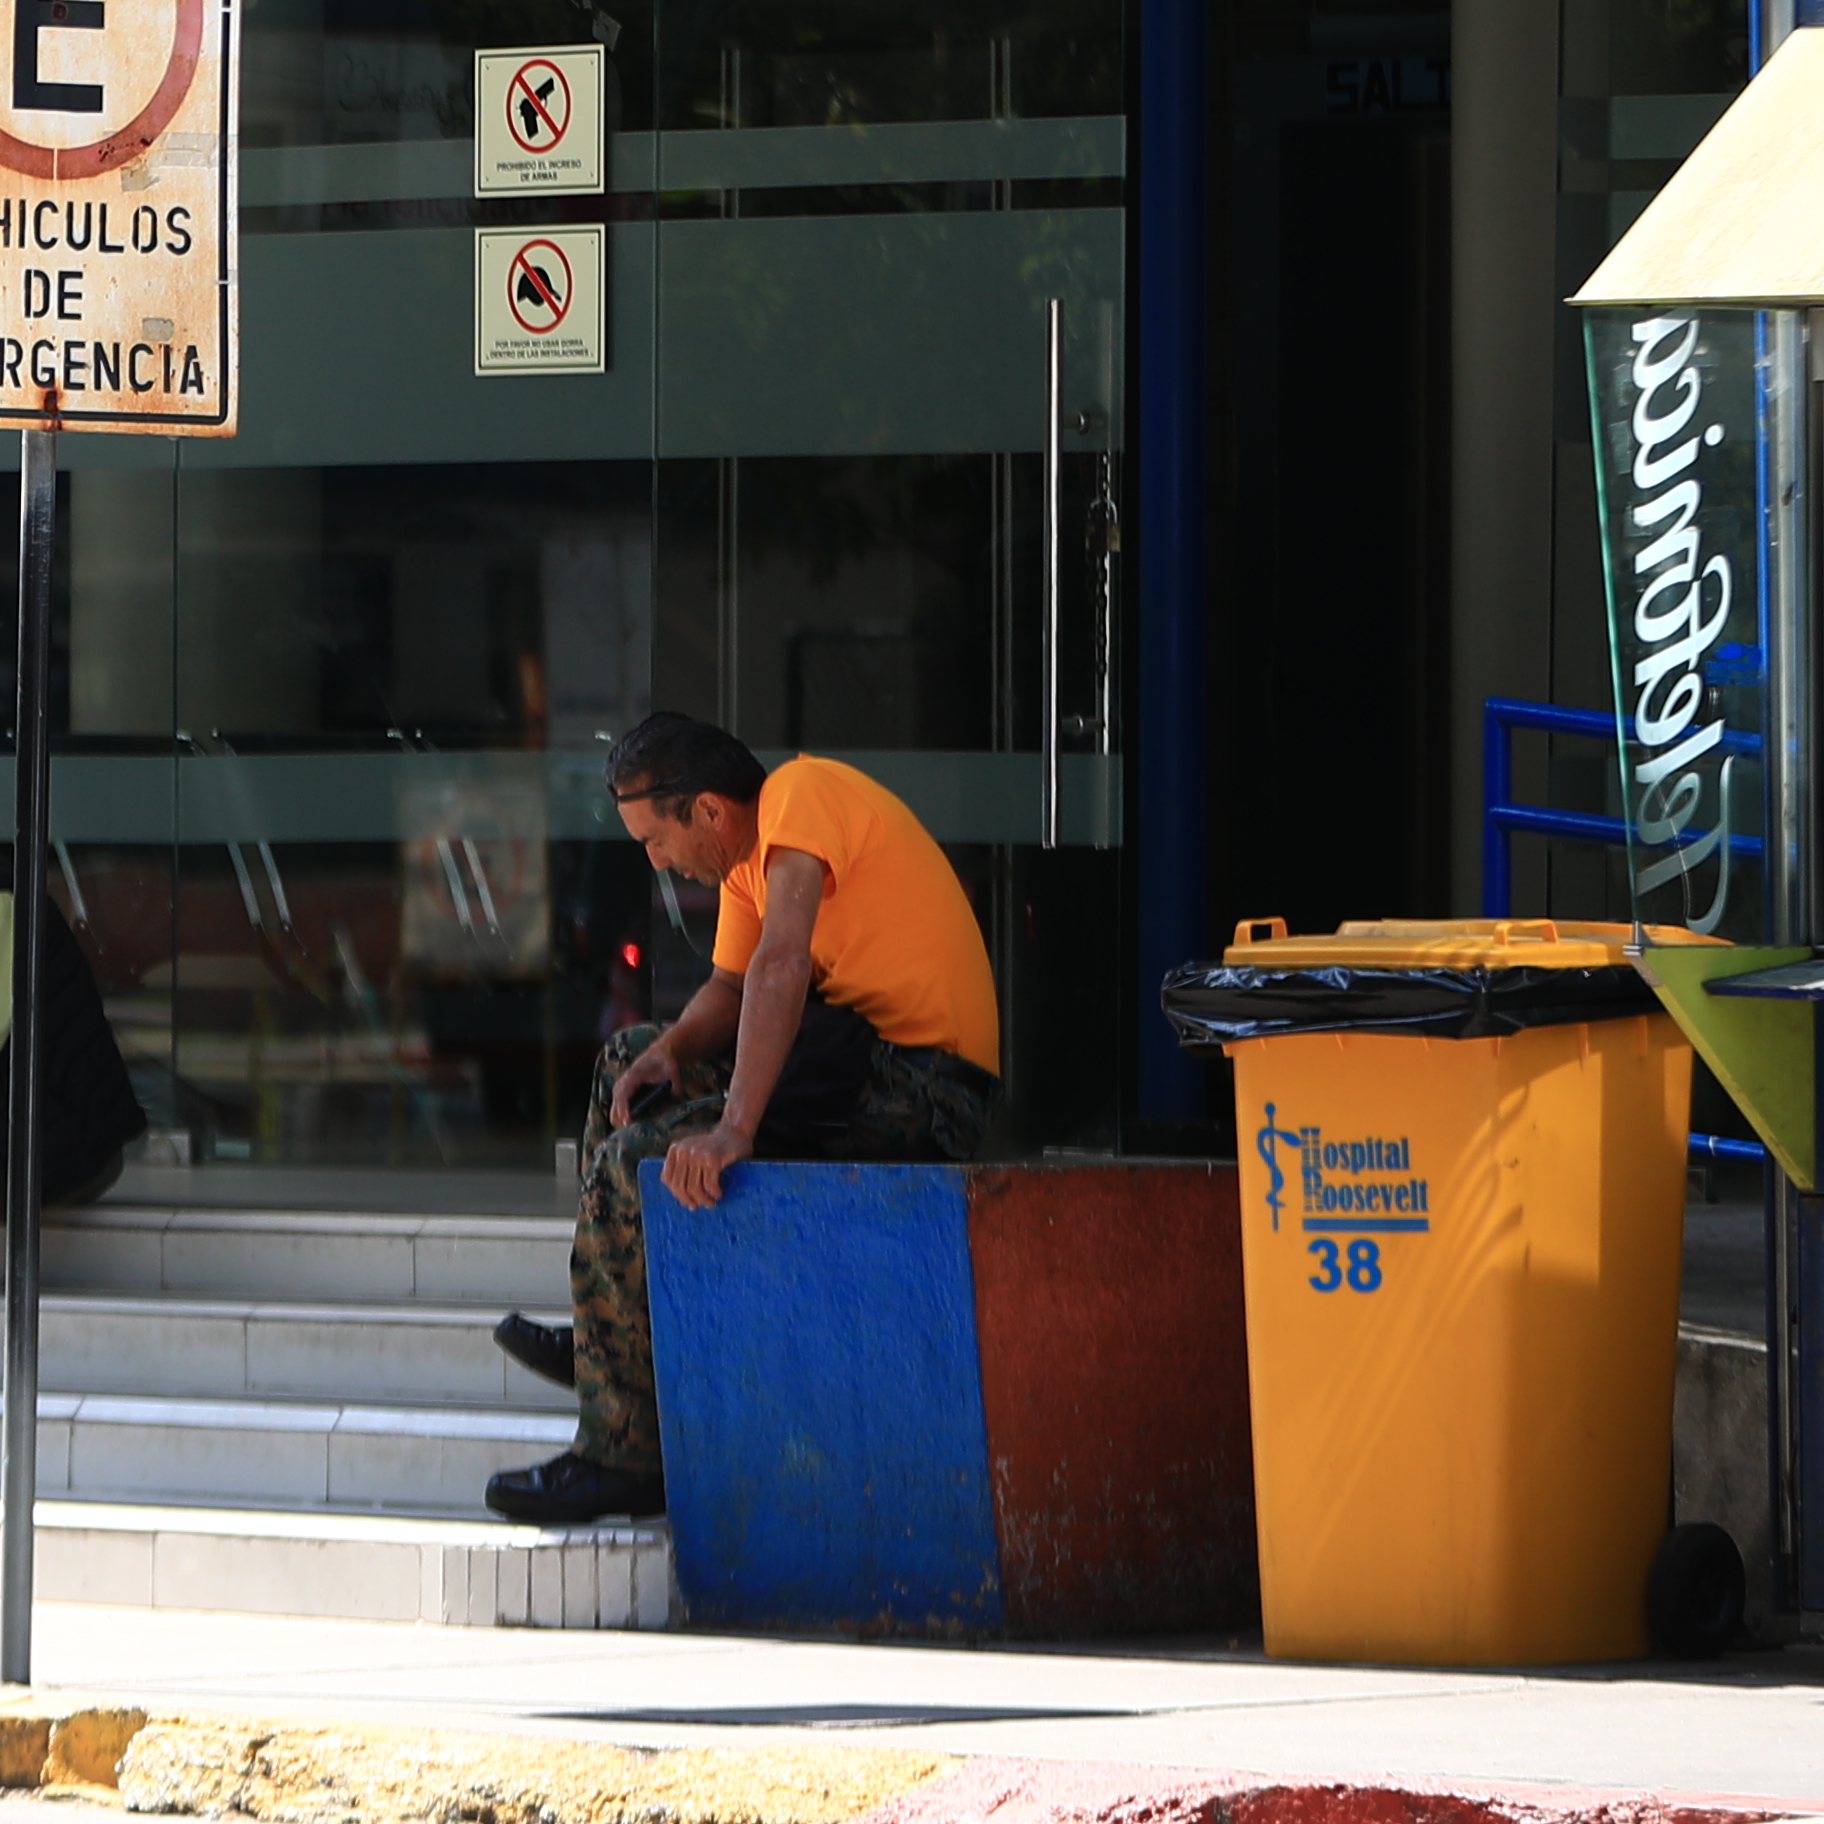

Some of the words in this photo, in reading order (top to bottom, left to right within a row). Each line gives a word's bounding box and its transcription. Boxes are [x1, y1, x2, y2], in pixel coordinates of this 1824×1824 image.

[23, 268, 84, 321] DE
[1299, 1127, 1410, 1176] Hospital
[1302, 1166, 1429, 1213] Roosevelt
[1308, 1237, 1383, 1294] 38
